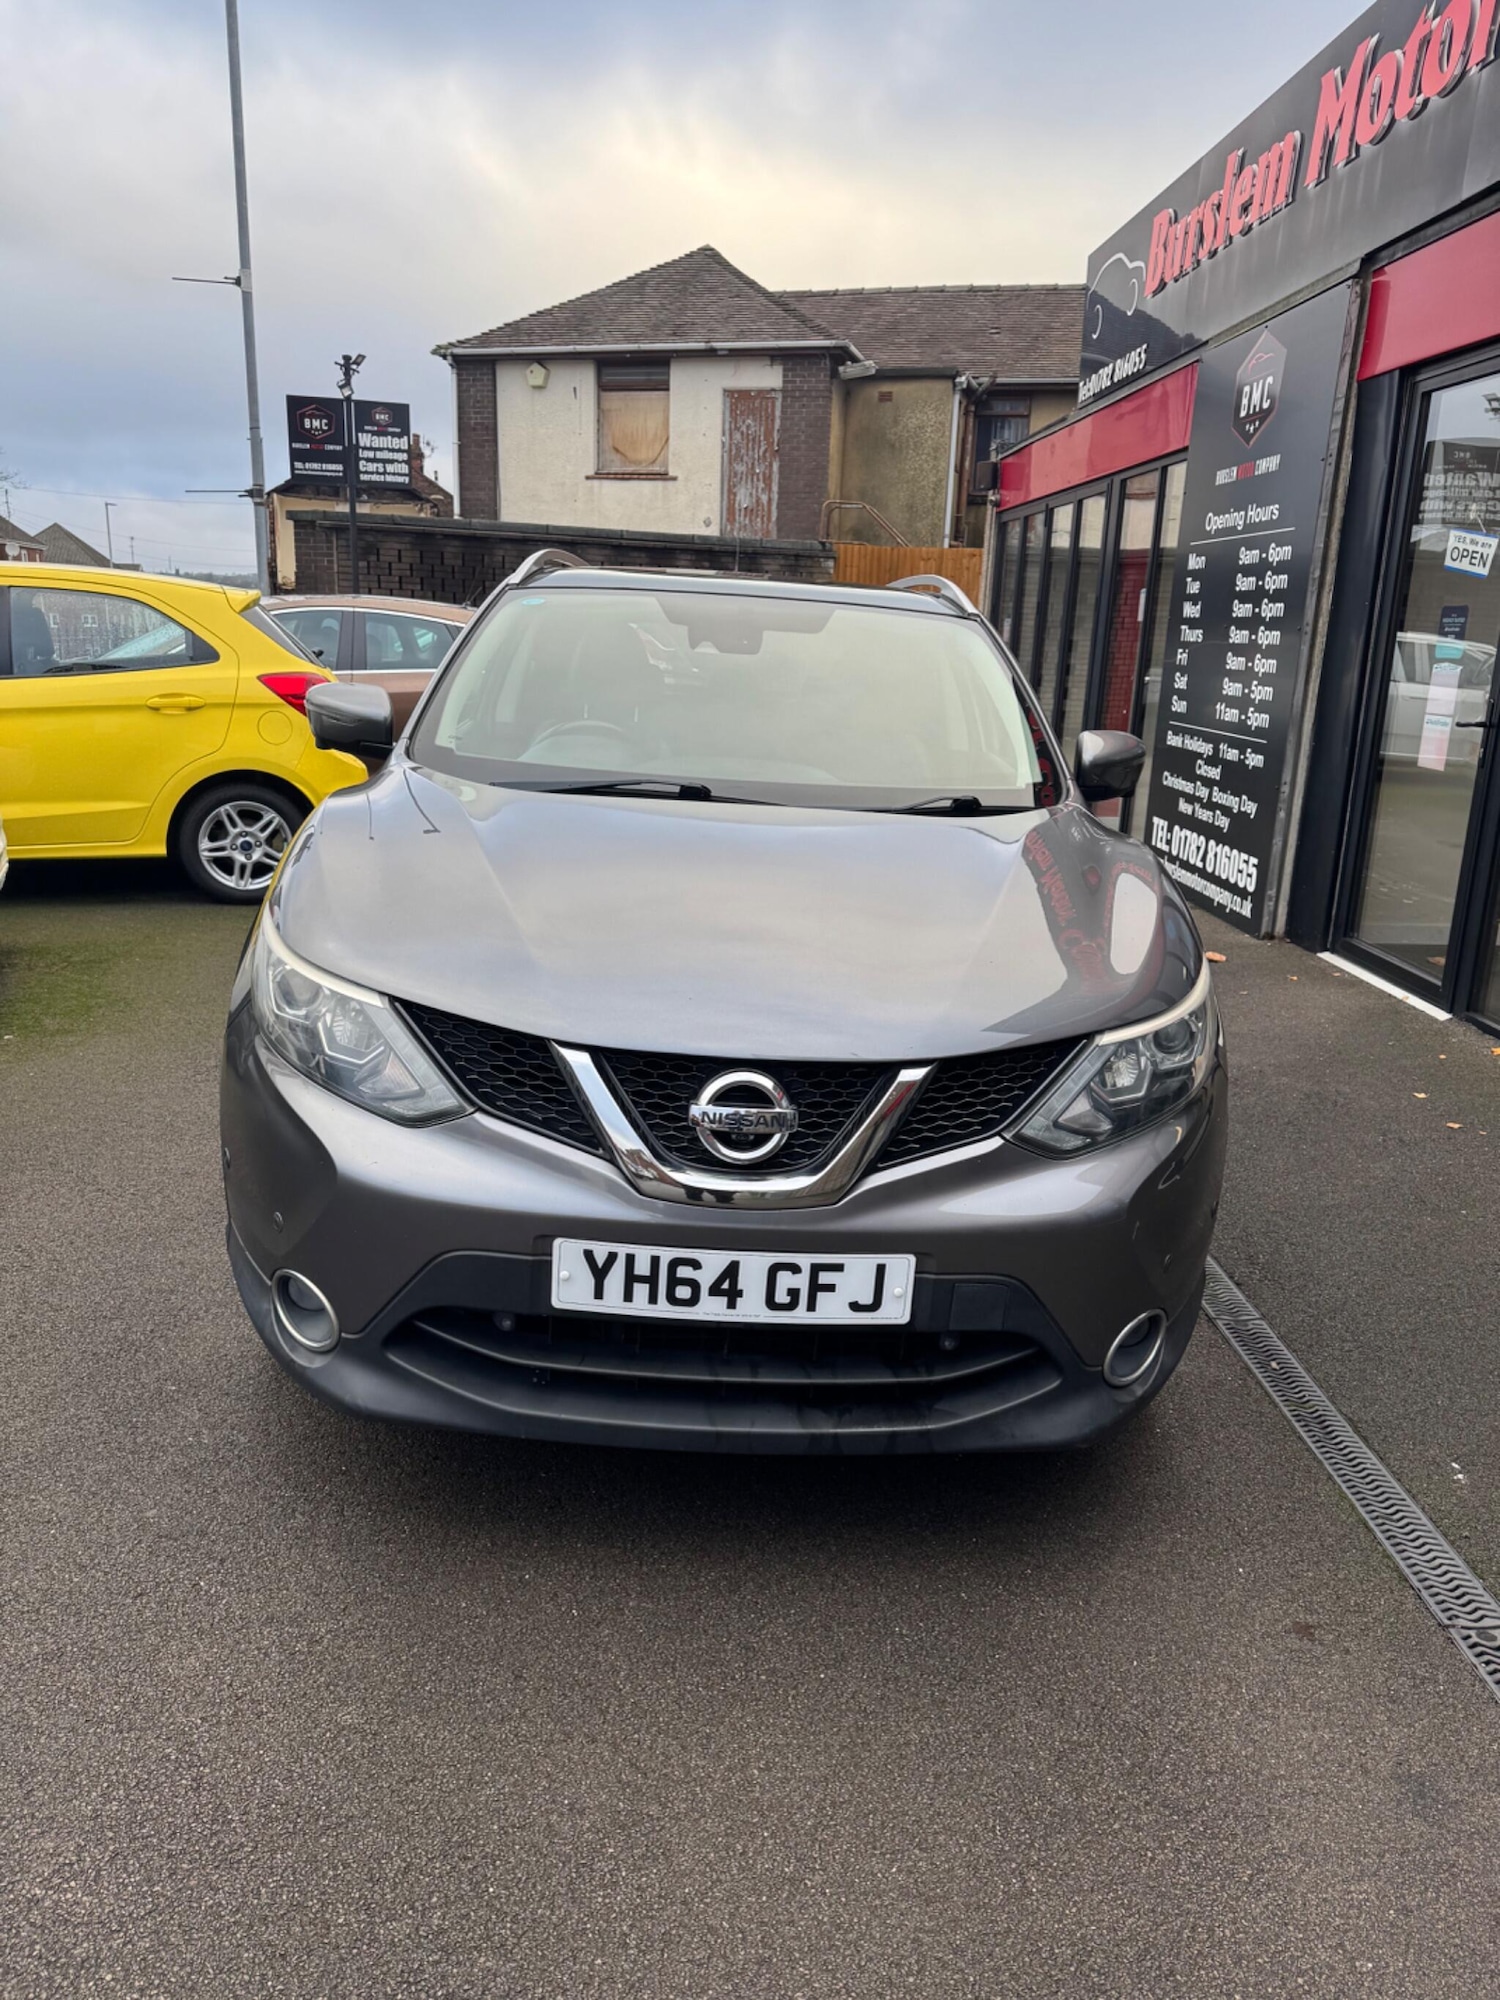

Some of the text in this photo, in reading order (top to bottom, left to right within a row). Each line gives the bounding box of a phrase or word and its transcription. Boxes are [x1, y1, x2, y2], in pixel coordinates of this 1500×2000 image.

[1144, 131, 1301, 298] Burslem
[1113, 343, 1148, 383] 816055
[1240, 376, 1273, 418] BMC
[304, 418, 328, 430] BMC
[358, 433, 408, 450] Wanted
[359, 449, 408, 461] Low mileage
[359, 460, 409, 474] Cars with
[1205, 503, 1280, 535] Opening Hours
[1187, 552, 1206, 571] Mon
[1238, 547, 1260, 565] 9am
[1268, 542, 1292, 567] 6pm
[1450, 546, 1489, 568] OPEN
[1186, 577, 1201, 594] Tue
[1235, 573, 1256, 592] 9am
[1264, 570, 1288, 594] 6pm
[1183, 601, 1201, 618] Wed
[1232, 600, 1253, 618] 9am
[1261, 598, 1285, 621] 6pm
[1180, 625, 1203, 643] Thurs
[1229, 626, 1249, 644] 9am
[1258, 626, 1281, 649] 6pm
[1176, 649, 1189, 666] Fri
[1225, 652, 1246, 671] 9am
[1254, 653, 1277, 677] 6pm
[1174, 672, 1188, 690] Sat
[1222, 678, 1243, 698] 9am
[1250, 679, 1274, 704] 5pm
[1171, 695, 1187, 714] Sun
[1215, 702, 1239, 723] 11am
[1247, 706, 1270, 730] 5pm
[1166, 730, 1183, 748] Bank
[1183, 734, 1214, 759] Holidays
[1219, 742, 1239, 762] 11am
[1245, 748, 1265, 770] 5pm
[1195, 759, 1222, 781] Closed
[1162, 771, 1258, 819] Christmas Day Boxing Day
[1178, 797, 1231, 833] New Years Day
[1152, 816, 1171, 852] TEL:
[1171, 825, 1206, 869] 01782
[1205, 839, 1259, 893] 816055
[701, 1111, 786, 1129] NISSAN
[583, 1248, 887, 1313] YH64 GFJ
